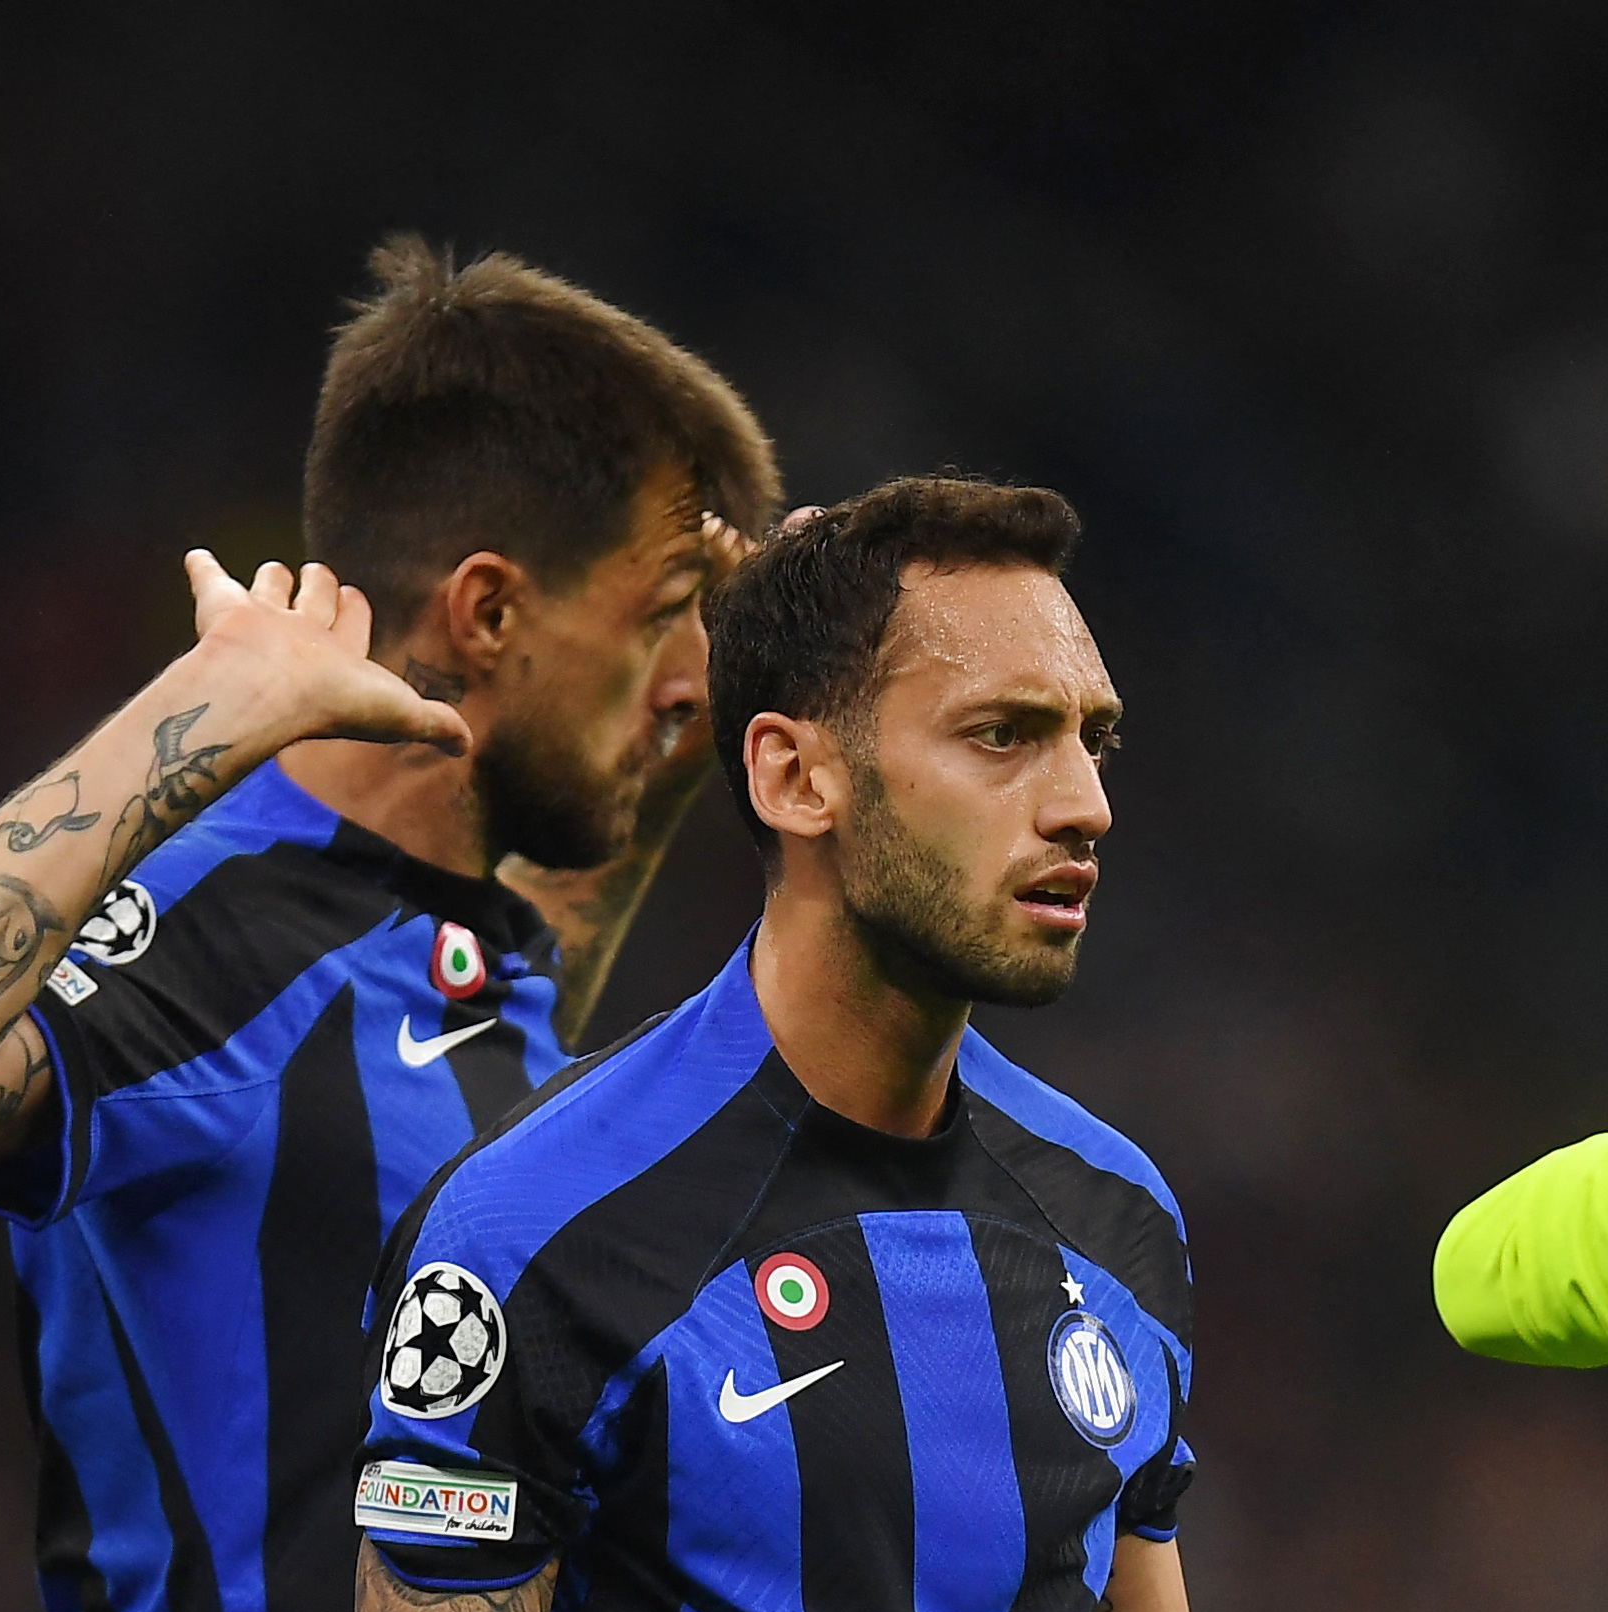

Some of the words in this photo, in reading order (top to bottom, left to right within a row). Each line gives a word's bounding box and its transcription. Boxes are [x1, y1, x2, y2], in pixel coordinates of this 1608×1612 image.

[359, 1480, 511, 1516] FOUNDATION
[445, 1516, 463, 1532] for
[465, 1518, 508, 1534] children
